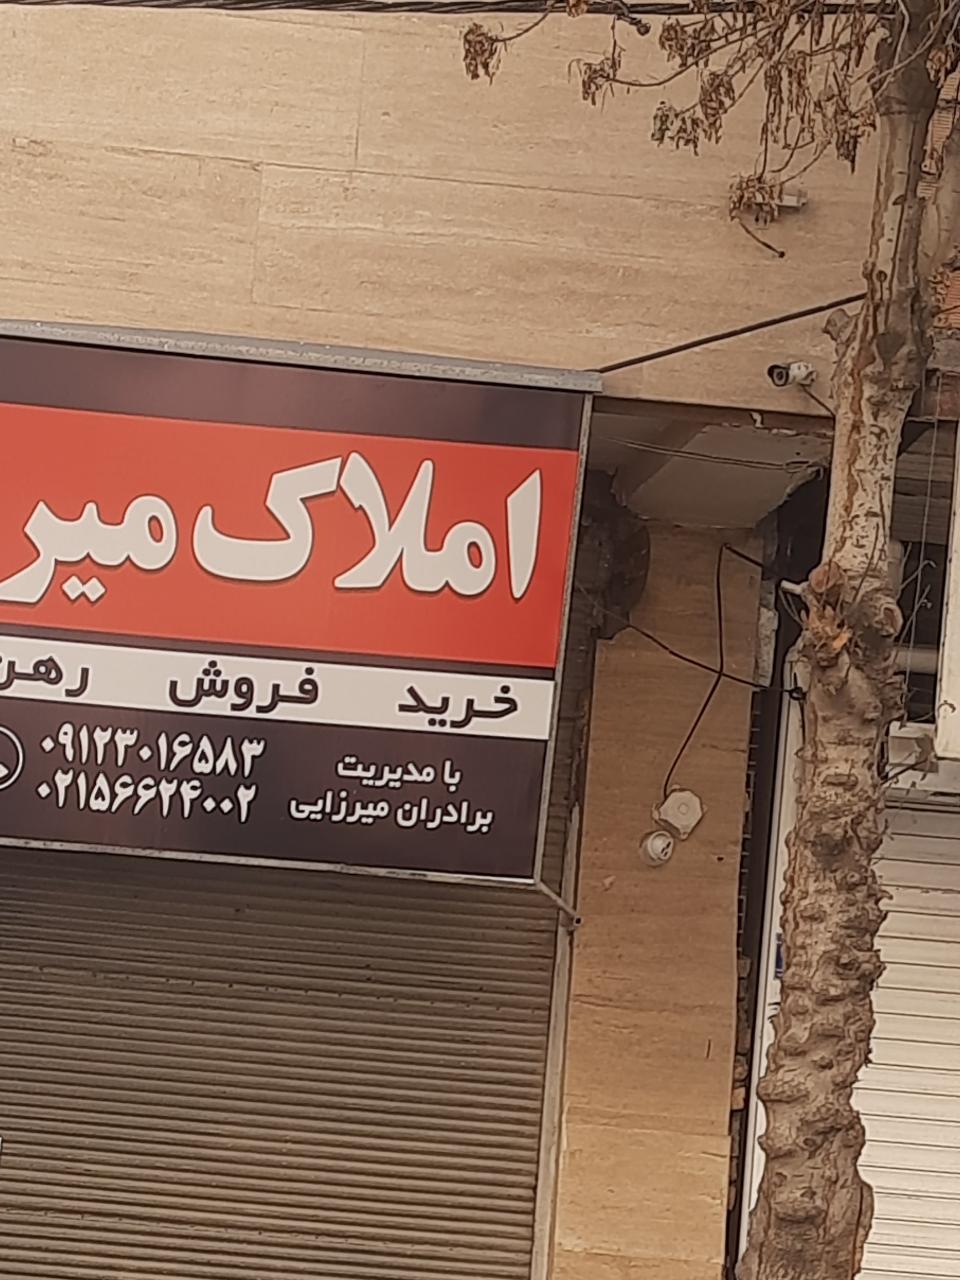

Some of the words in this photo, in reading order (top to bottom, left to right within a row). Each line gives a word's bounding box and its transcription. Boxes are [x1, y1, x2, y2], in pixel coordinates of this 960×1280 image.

[193, 450, 543, 601] املاک
[169, 660, 319, 713] فروش
[398, 684, 519, 729] خرید
[41, 722, 266, 778] ۰۹۱۲۳۰۱۶۵۸۳
[337, 755, 436, 788] مدیریت
[37, 769, 257, 823] ۰۲۱۵۶۶۲۴۰۰۲
[442, 760, 462, 791] با
[289, 790, 390, 825] میرزایی
[396, 798, 494, 833] برادران
